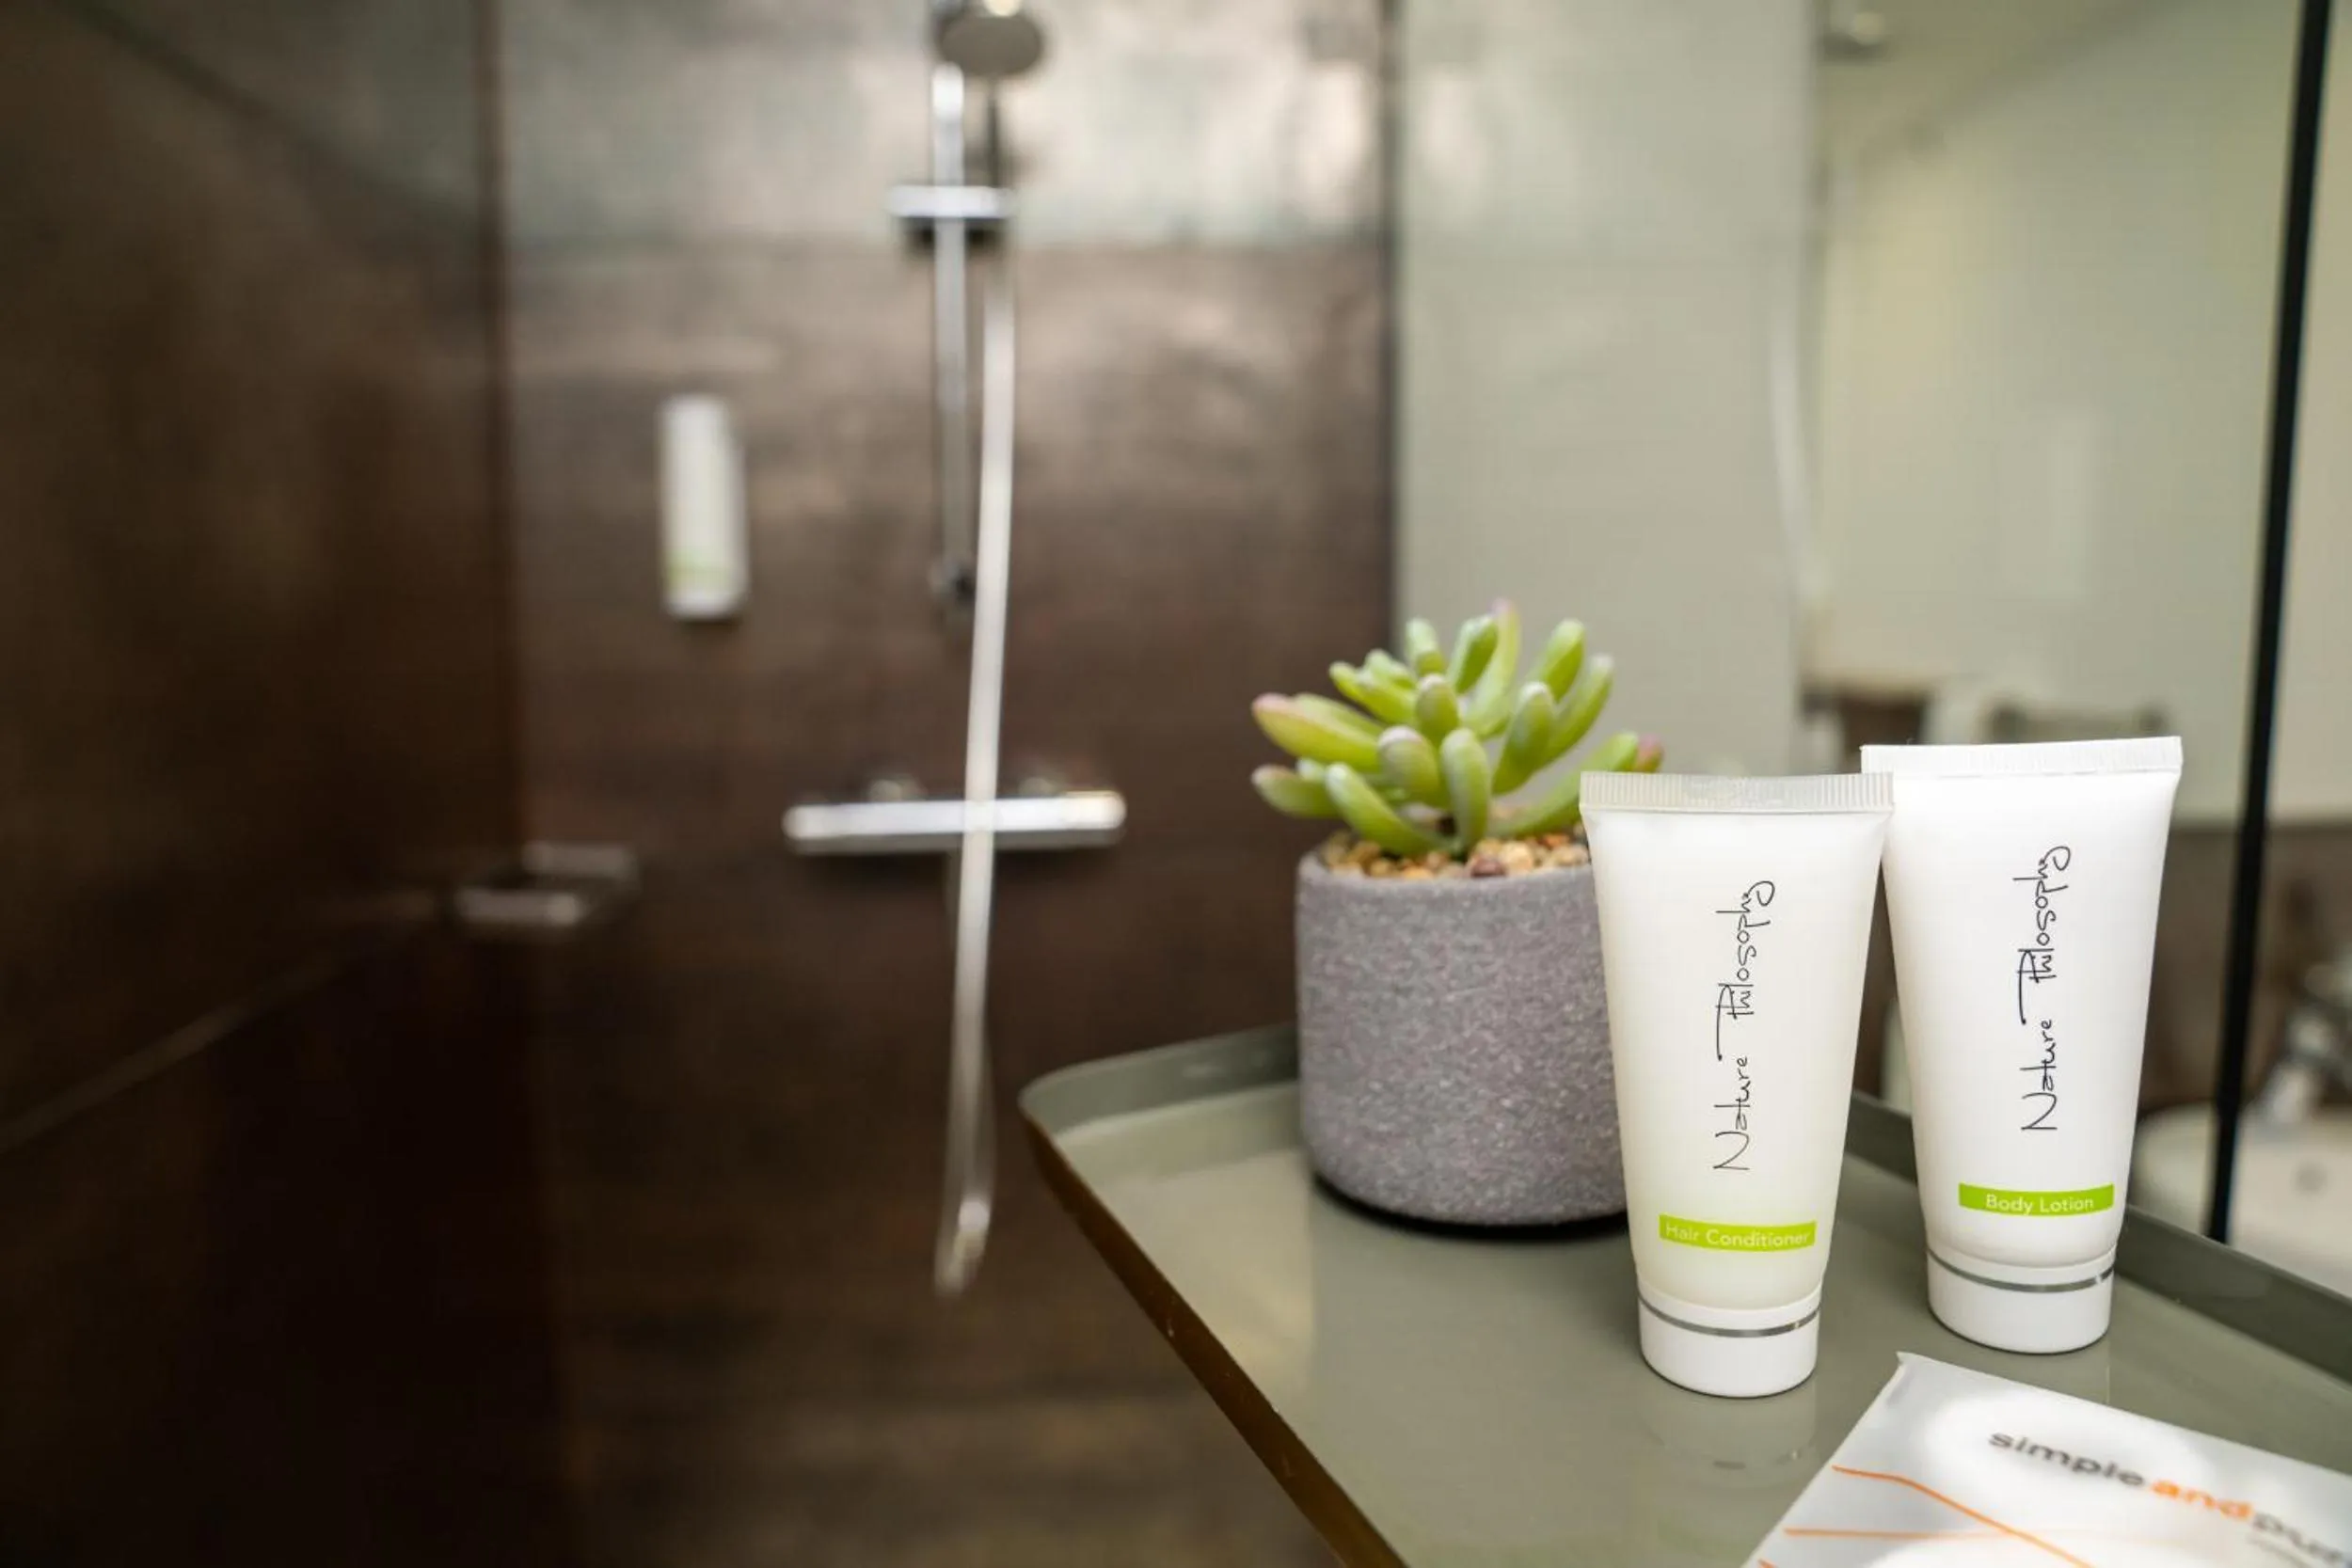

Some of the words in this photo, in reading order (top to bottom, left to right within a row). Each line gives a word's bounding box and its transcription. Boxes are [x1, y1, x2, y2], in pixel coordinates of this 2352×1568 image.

[1714, 880, 1776, 1062] Philosophy
[2011, 846, 2072, 1026] Philosophy
[1711, 1055, 1752, 1171] Nature
[2019, 1019, 2058, 1132] Nature
[1664, 1222, 1700, 1242] Hair
[1705, 1227, 1812, 1248] Conditioner
[1985, 1192, 2034, 1216] Body
[2039, 1196, 2095, 1213] Lotion
